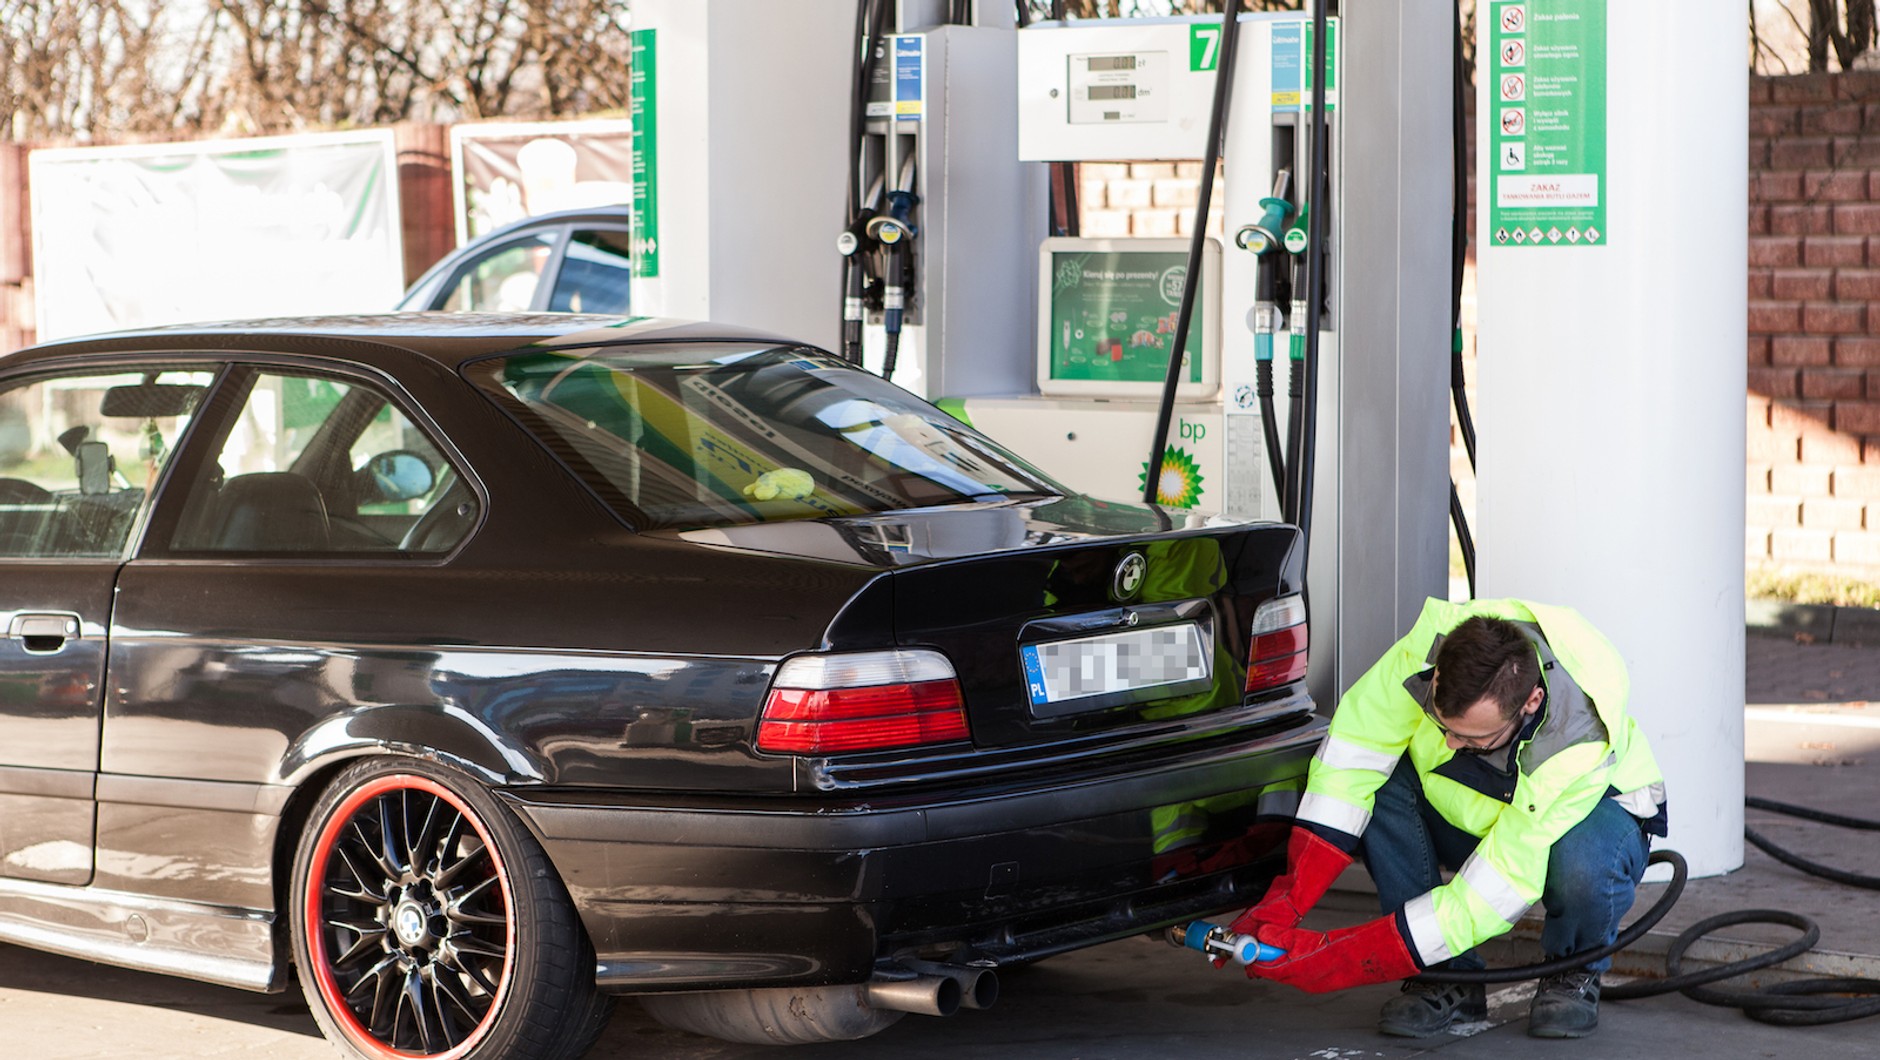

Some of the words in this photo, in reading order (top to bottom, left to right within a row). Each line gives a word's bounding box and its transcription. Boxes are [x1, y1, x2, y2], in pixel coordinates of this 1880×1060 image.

[1195, 29, 1220, 69] 7
[1531, 183, 1561, 192] ZAKAZ
[1115, 272, 1125, 280] po
[1179, 417, 1206, 444] bp
[1030, 683, 1045, 698] PL
